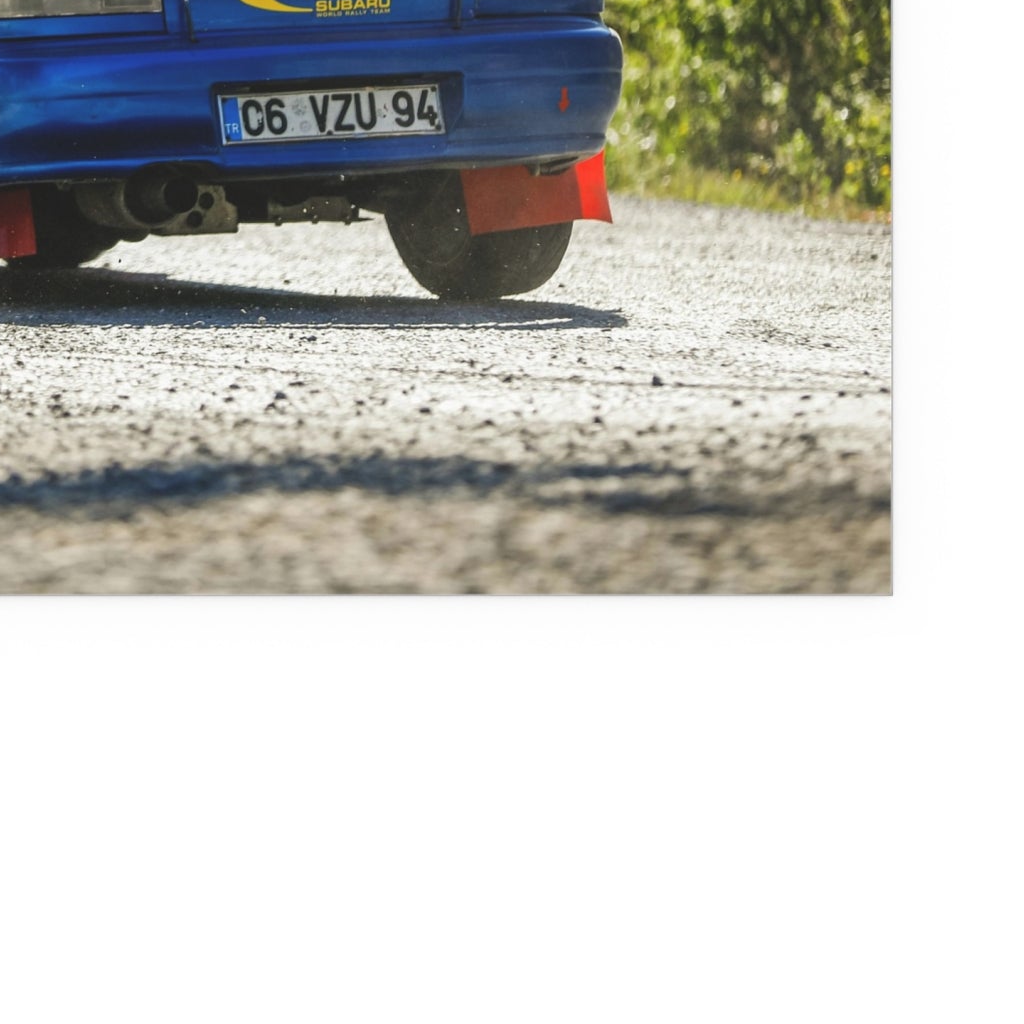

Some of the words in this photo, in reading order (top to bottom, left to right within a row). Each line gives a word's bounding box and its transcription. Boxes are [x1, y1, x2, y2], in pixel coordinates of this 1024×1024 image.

[316, 10, 343, 18] WORLD
[345, 9, 367, 17] RALLY
[370, 7, 391, 15] TEAM
[309, 92, 378, 134] VZU
[392, 88, 439, 127] 94
[225, 122, 240, 135] TR
